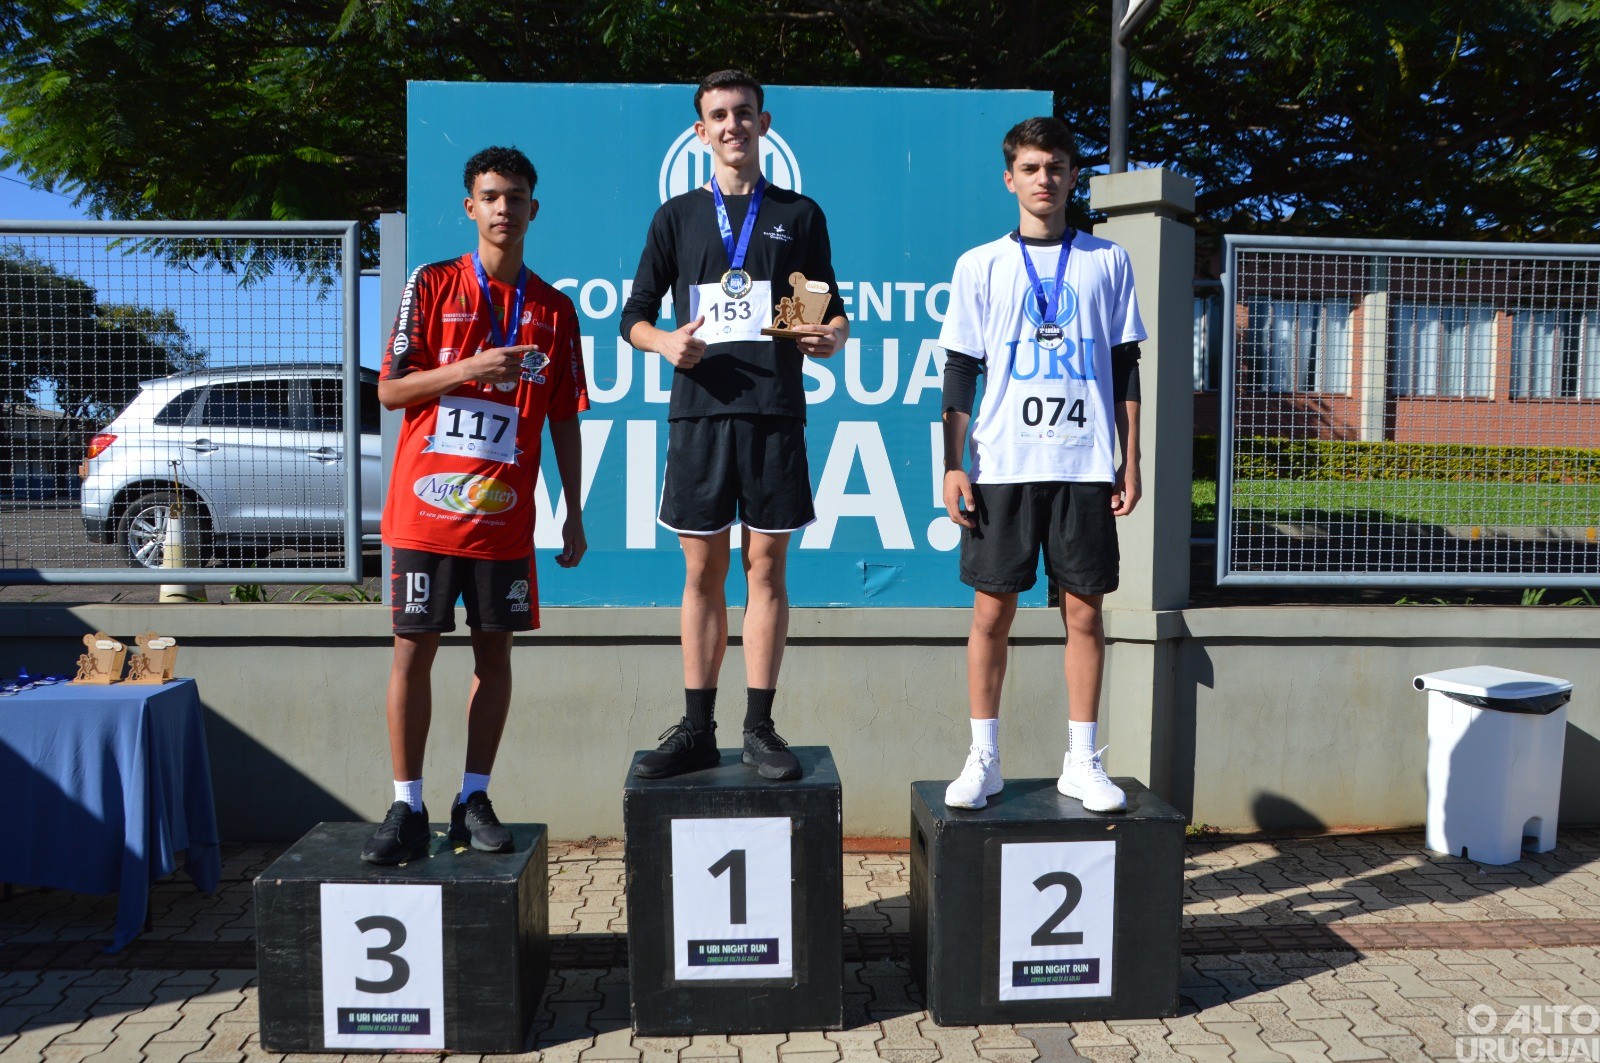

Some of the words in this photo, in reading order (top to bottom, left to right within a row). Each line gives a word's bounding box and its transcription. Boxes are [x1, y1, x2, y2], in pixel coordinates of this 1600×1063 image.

[709, 300, 752, 322] 153
[802, 338, 945, 405] SUA
[1006, 338, 1097, 381] URI
[446, 408, 511, 444] 117
[1022, 396, 1087, 428] 074
[534, 420, 962, 552] VIA!
[437, 513, 462, 521] parceiro
[406, 572, 430, 603] 19
[708, 849, 747, 925] 1
[1031, 871, 1083, 946] 2
[354, 915, 411, 994] 3
[706, 945, 720, 954] URI
[722, 944, 748, 953] NIGHT
[750, 944, 768, 953] RUN
[1030, 965, 1043, 975] URI
[1045, 964, 1070, 974] NIGHT
[1072, 963, 1089, 973] RUN
[356, 1013, 370, 1022] URI
[372, 1013, 399, 1023] NIGHT
[401, 1013, 419, 1023] RUN
